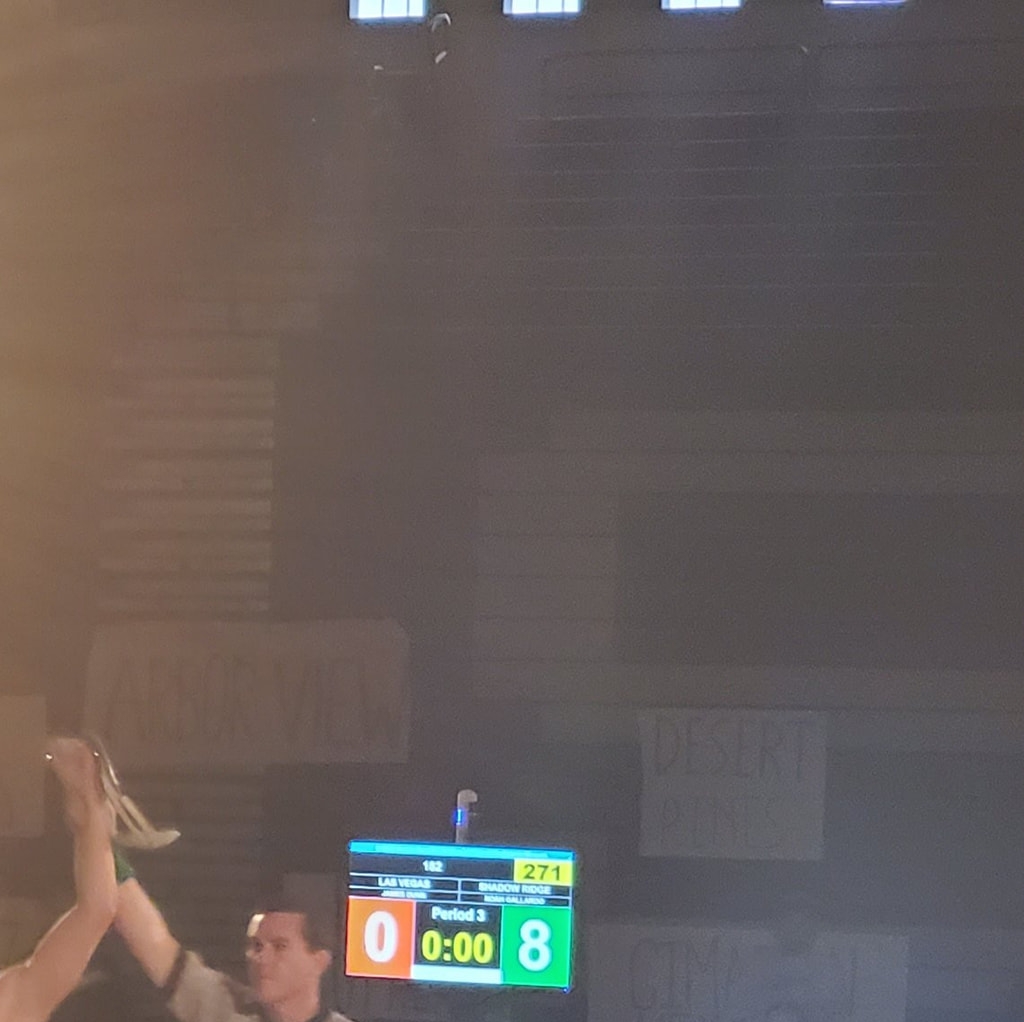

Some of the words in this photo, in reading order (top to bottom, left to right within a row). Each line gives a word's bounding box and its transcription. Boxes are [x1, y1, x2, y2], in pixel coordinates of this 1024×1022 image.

[654, 715, 816, 782] DESERT
[377, 876, 398, 888] LAS
[398, 878, 432, 890] VEGAS
[523, 864, 562, 881] 271
[478, 882, 521, 894] SHADOW
[521, 885, 553, 895] RIDGE
[432, 906, 475, 922] Period
[475, 908, 487, 923] 3
[363, 911, 398, 963] 0
[422, 929, 494, 964] 0:00
[518, 918, 553, 972] 8
